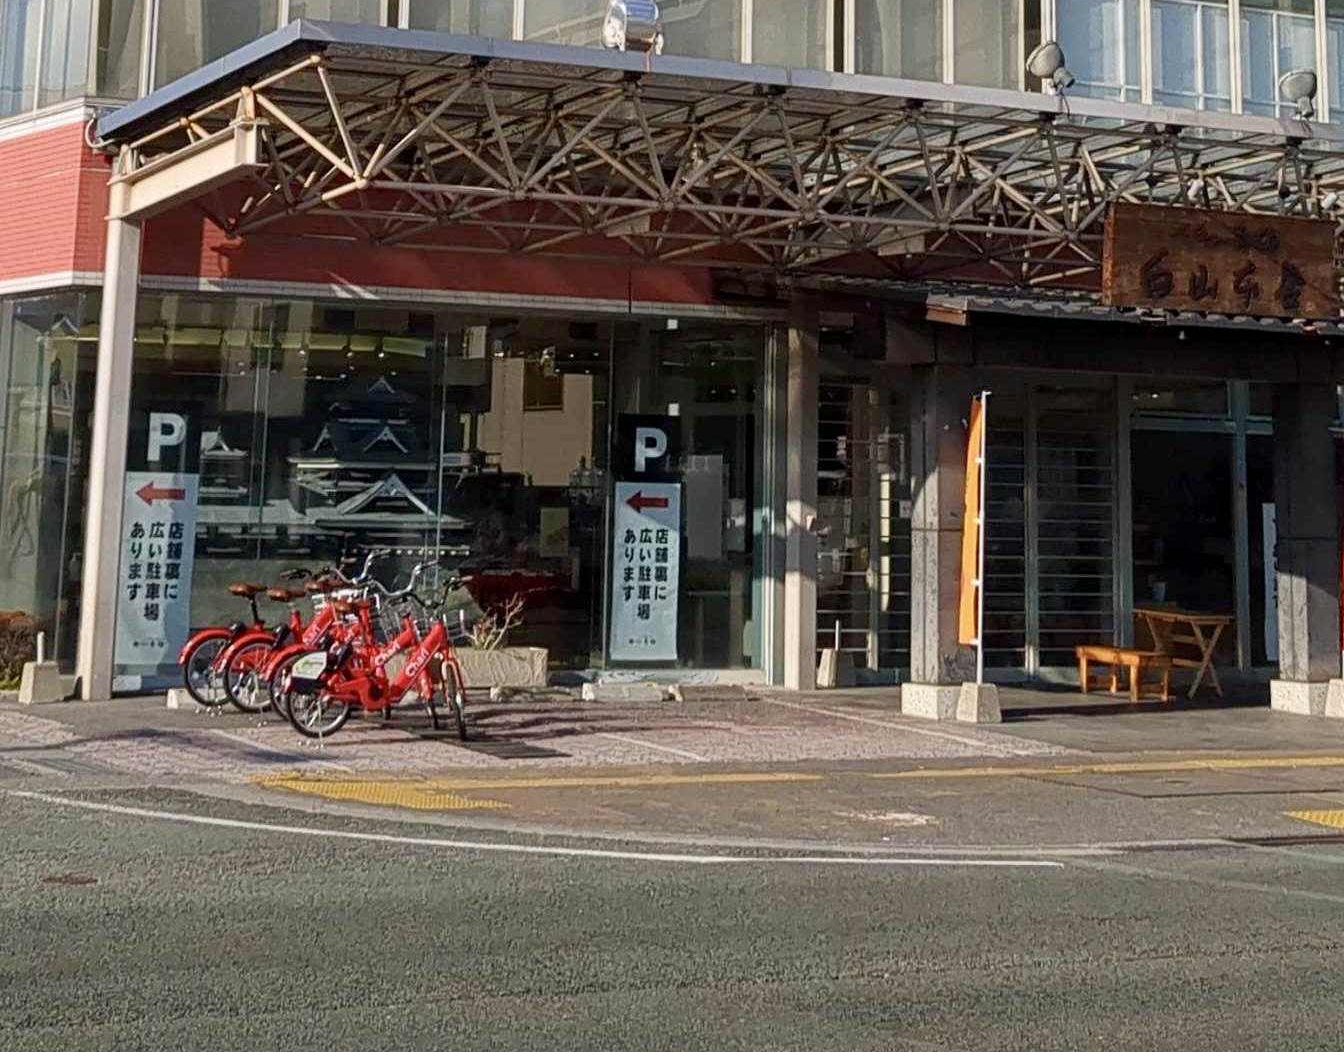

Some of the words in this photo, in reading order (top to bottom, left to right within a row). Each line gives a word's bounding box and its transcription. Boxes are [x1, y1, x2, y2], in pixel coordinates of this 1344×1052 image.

[147, 413, 187, 462] P
[635, 427, 668, 472] P
[127, 522, 145, 601] あります
[144, 522, 165, 621] 広い駐車場
[163, 522, 184, 599] 店舗裏に
[623, 529, 636, 601] あります
[637, 529, 653, 620] 広い駐車場
[654, 529, 669, 601] 店舗裏に
